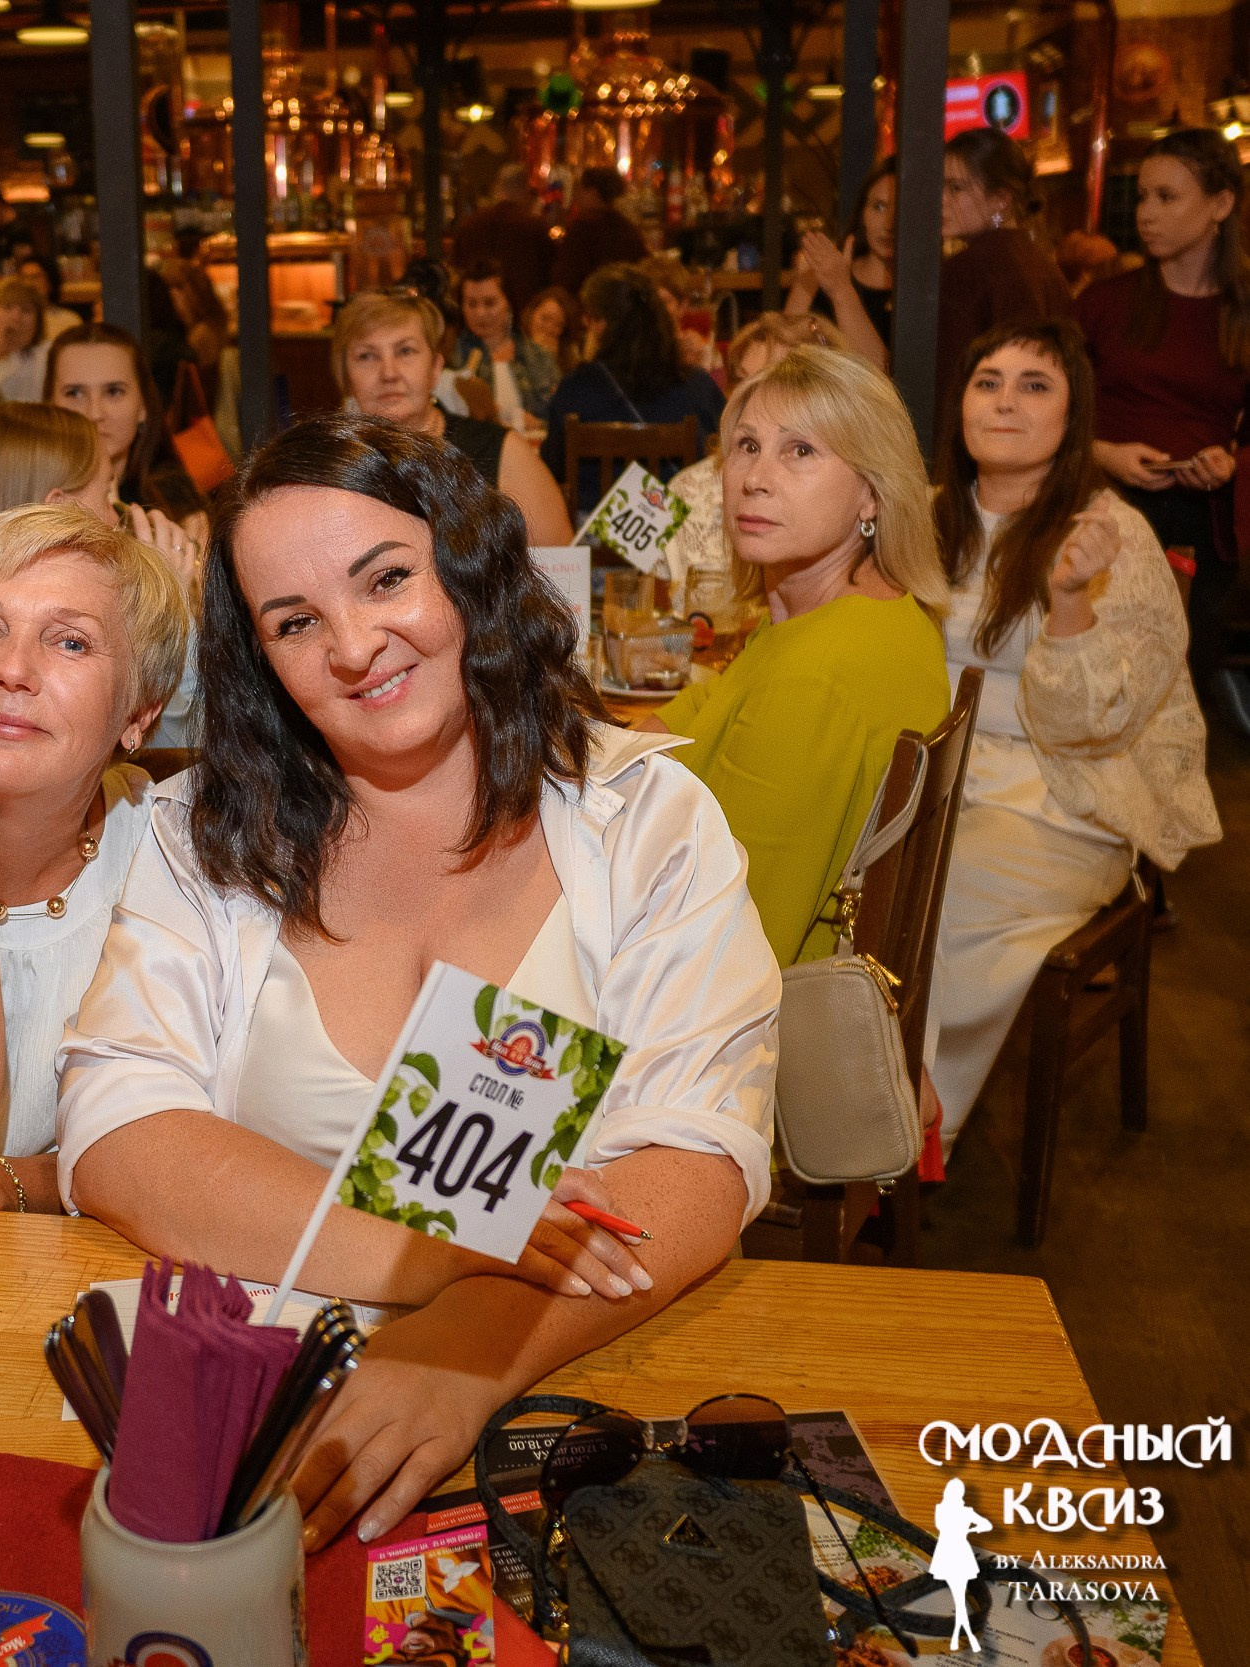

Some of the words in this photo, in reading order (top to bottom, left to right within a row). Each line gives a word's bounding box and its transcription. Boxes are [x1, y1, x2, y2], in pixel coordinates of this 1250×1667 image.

[611, 509, 658, 551] 405
[468, 1072, 509, 1104] СТОЛ
[507, 1088, 526, 1111] №
[396, 1099, 535, 1214] 404
[508, 1440, 542, 1451] 18.00
